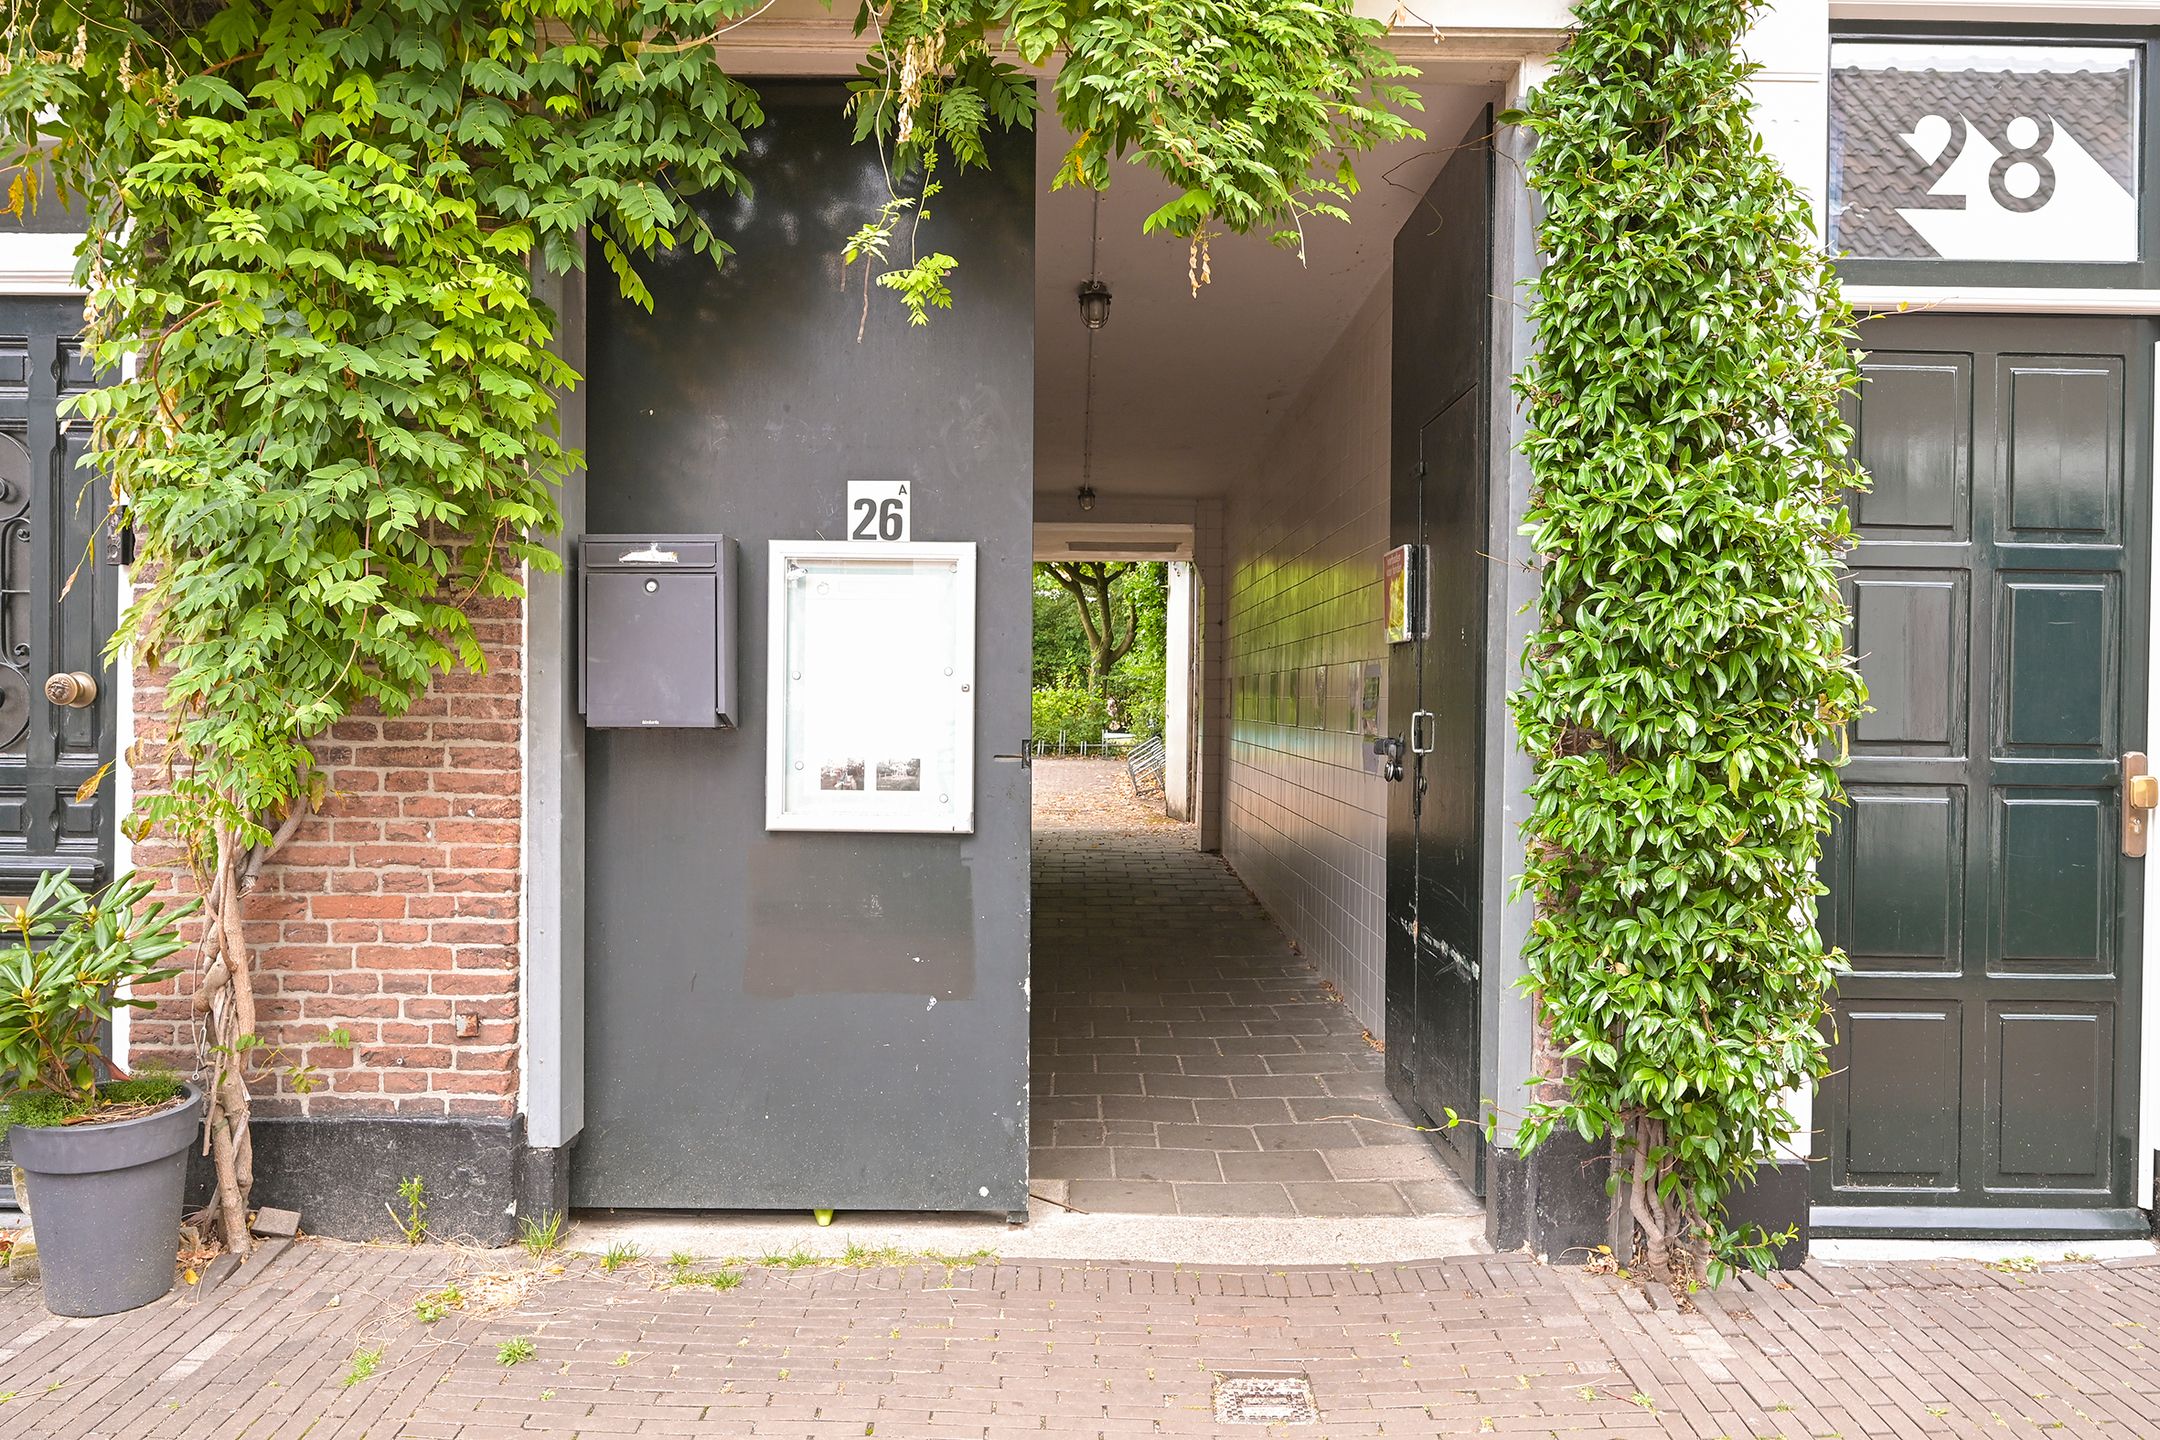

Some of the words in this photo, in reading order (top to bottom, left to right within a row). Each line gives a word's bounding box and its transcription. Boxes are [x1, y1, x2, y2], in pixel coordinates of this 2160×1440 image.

[1895, 112, 2056, 213] 28
[898, 484, 908, 496] A
[852, 498, 903, 541] 26
